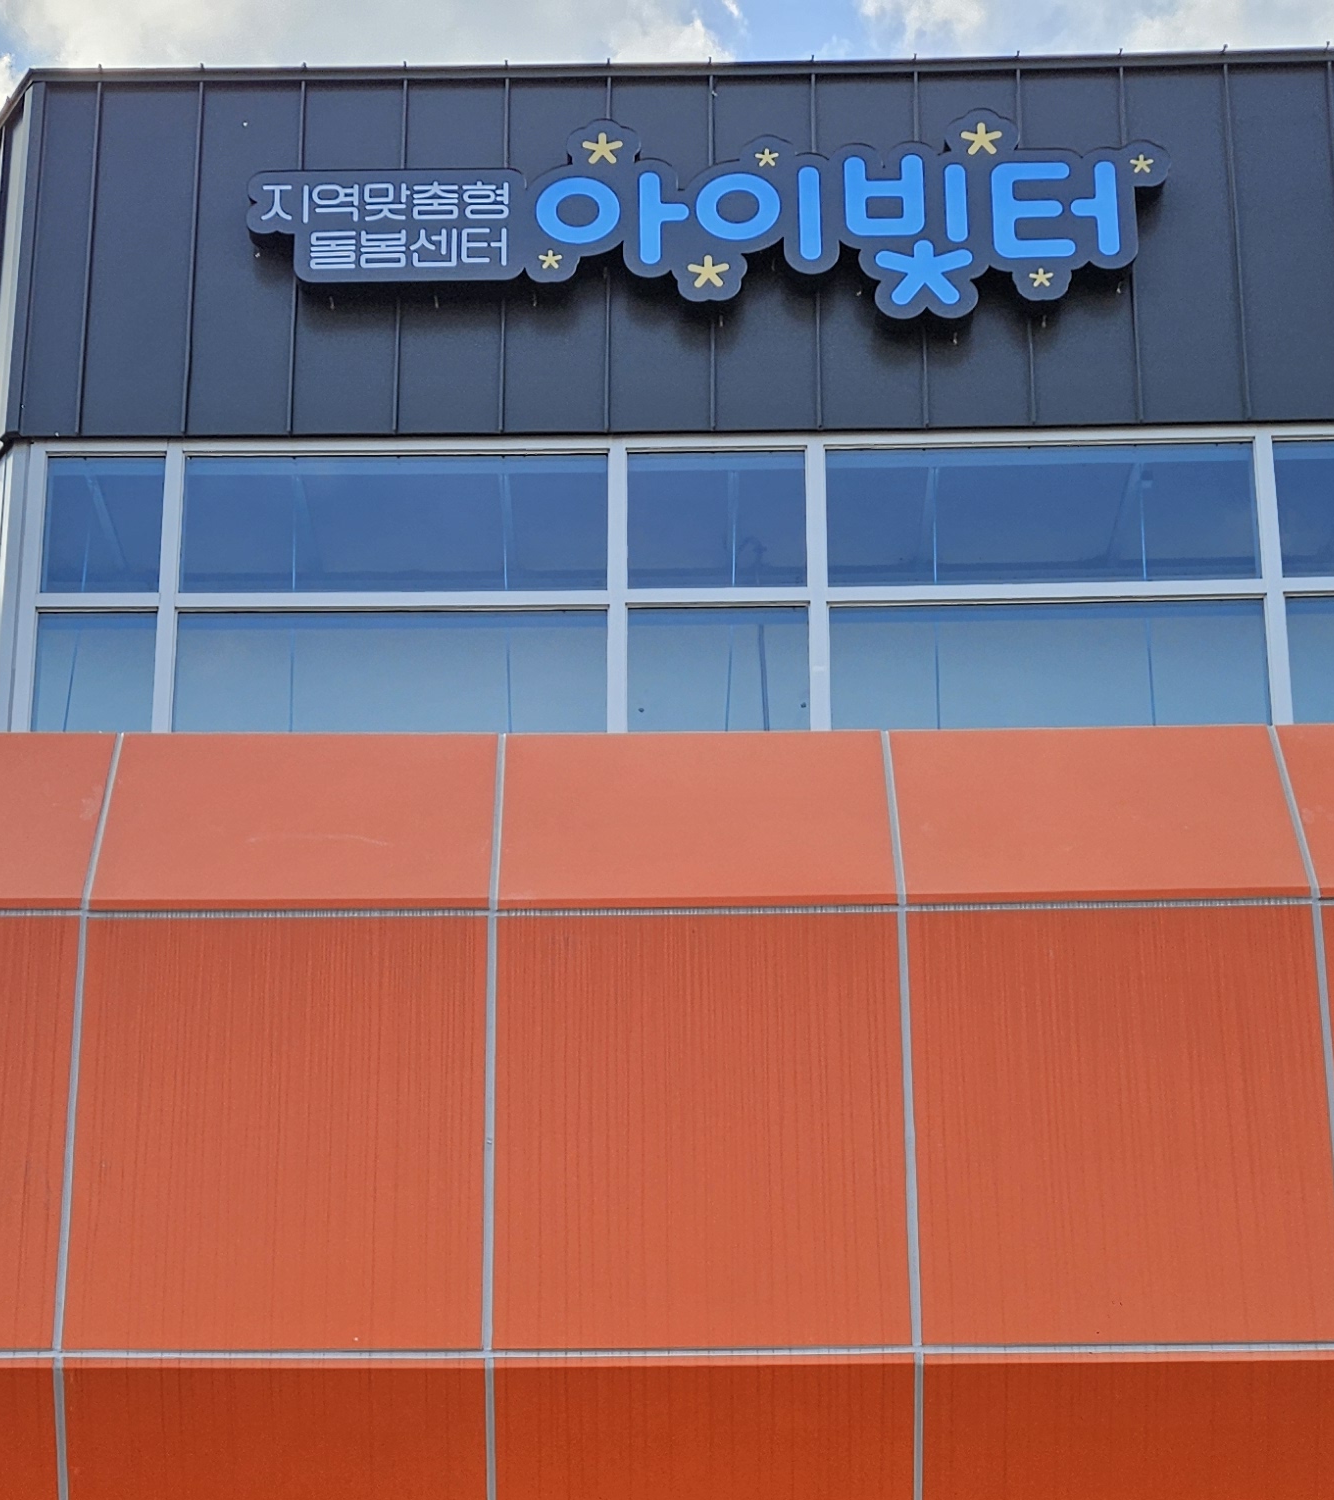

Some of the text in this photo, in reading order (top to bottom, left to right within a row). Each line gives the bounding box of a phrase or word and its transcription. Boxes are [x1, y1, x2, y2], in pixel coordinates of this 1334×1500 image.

[260, 180, 510, 224] 지역맞춤형
[309, 226, 508, 270] 돌봄센터
[535, 153, 1121, 306] 아이빛터
